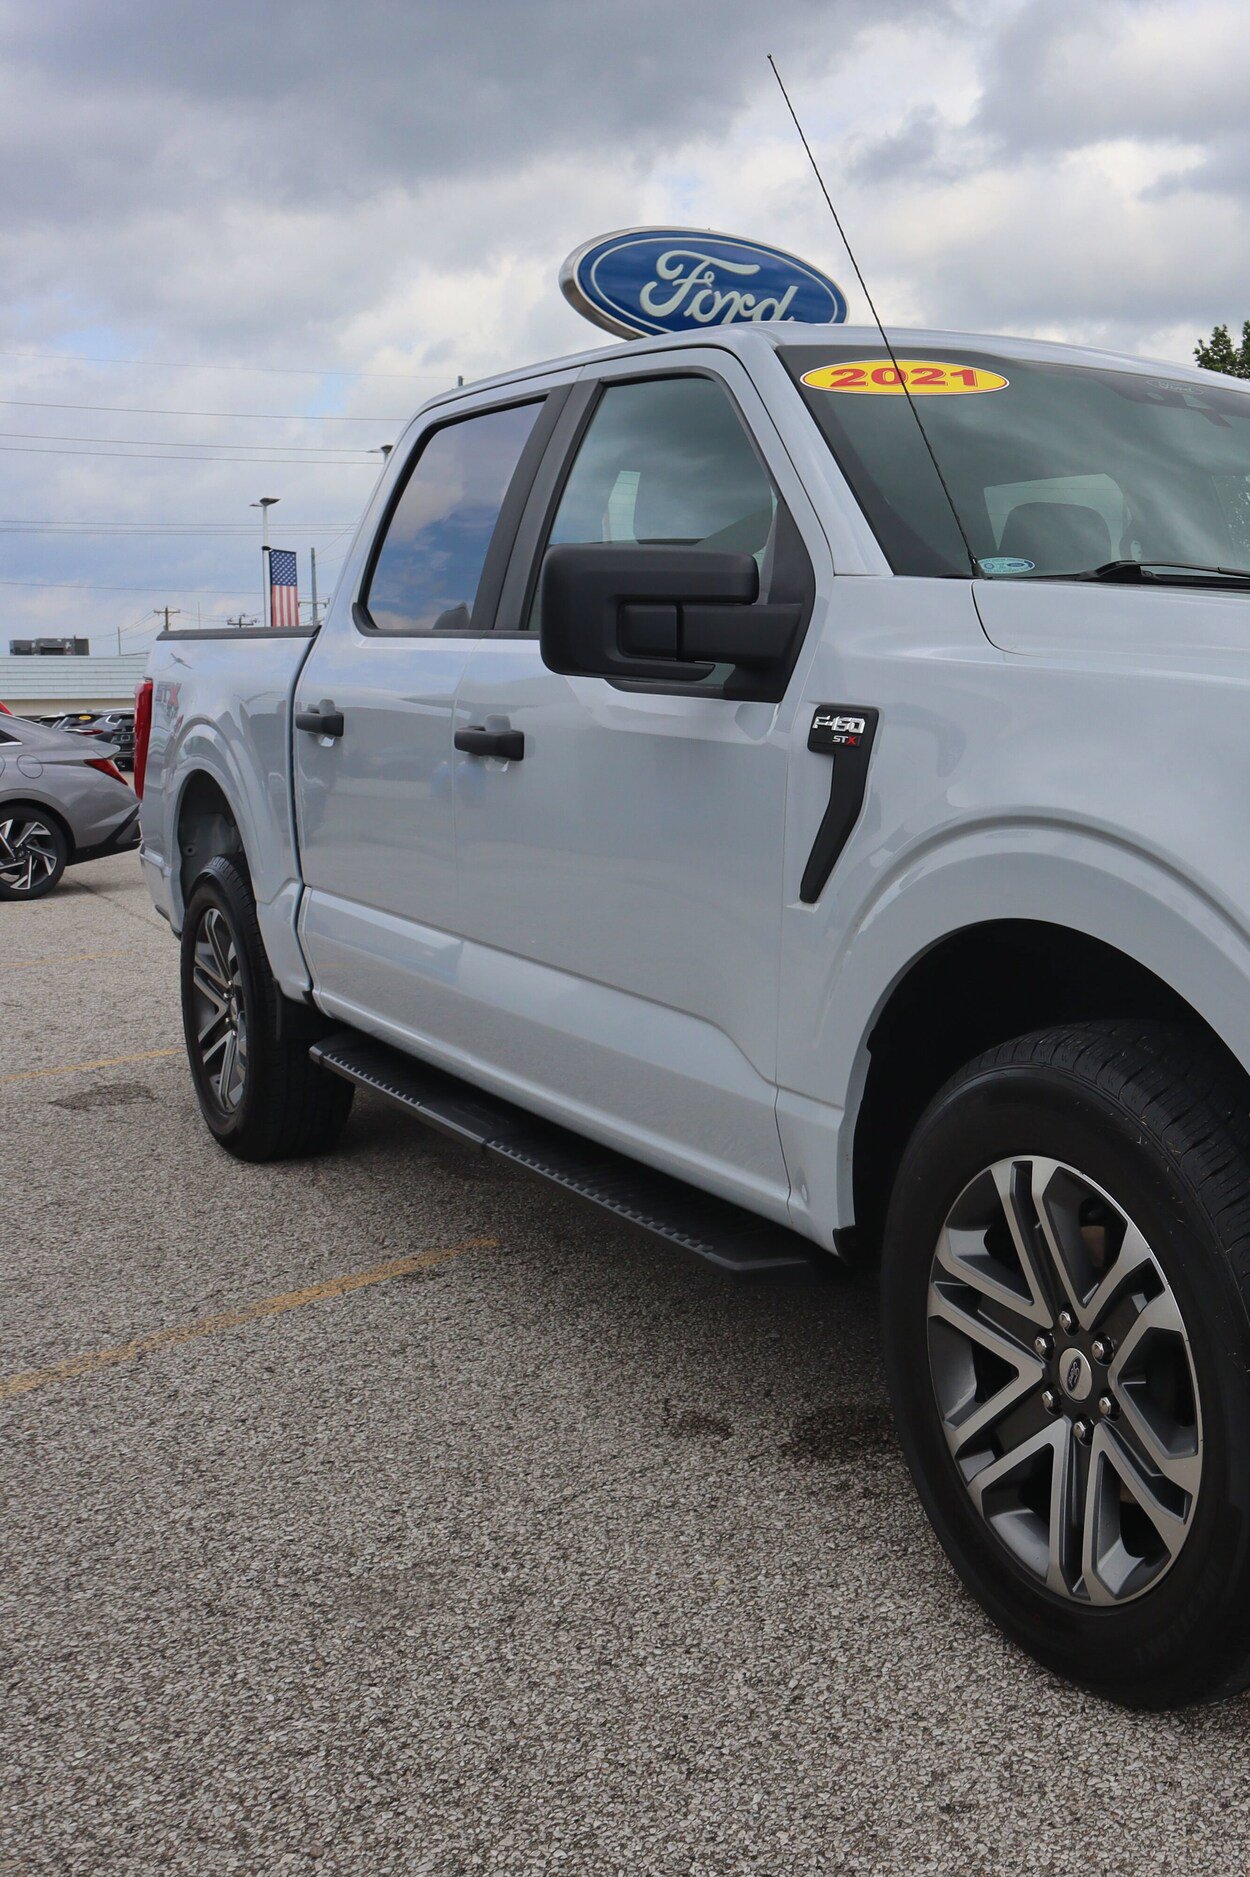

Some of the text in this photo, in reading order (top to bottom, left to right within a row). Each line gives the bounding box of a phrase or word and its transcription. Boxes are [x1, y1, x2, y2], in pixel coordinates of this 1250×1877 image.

[639, 249, 797, 323] Ford
[829, 366, 979, 388] 2021
[812, 715, 866, 734] F-150
[832, 735, 858, 745] STX
